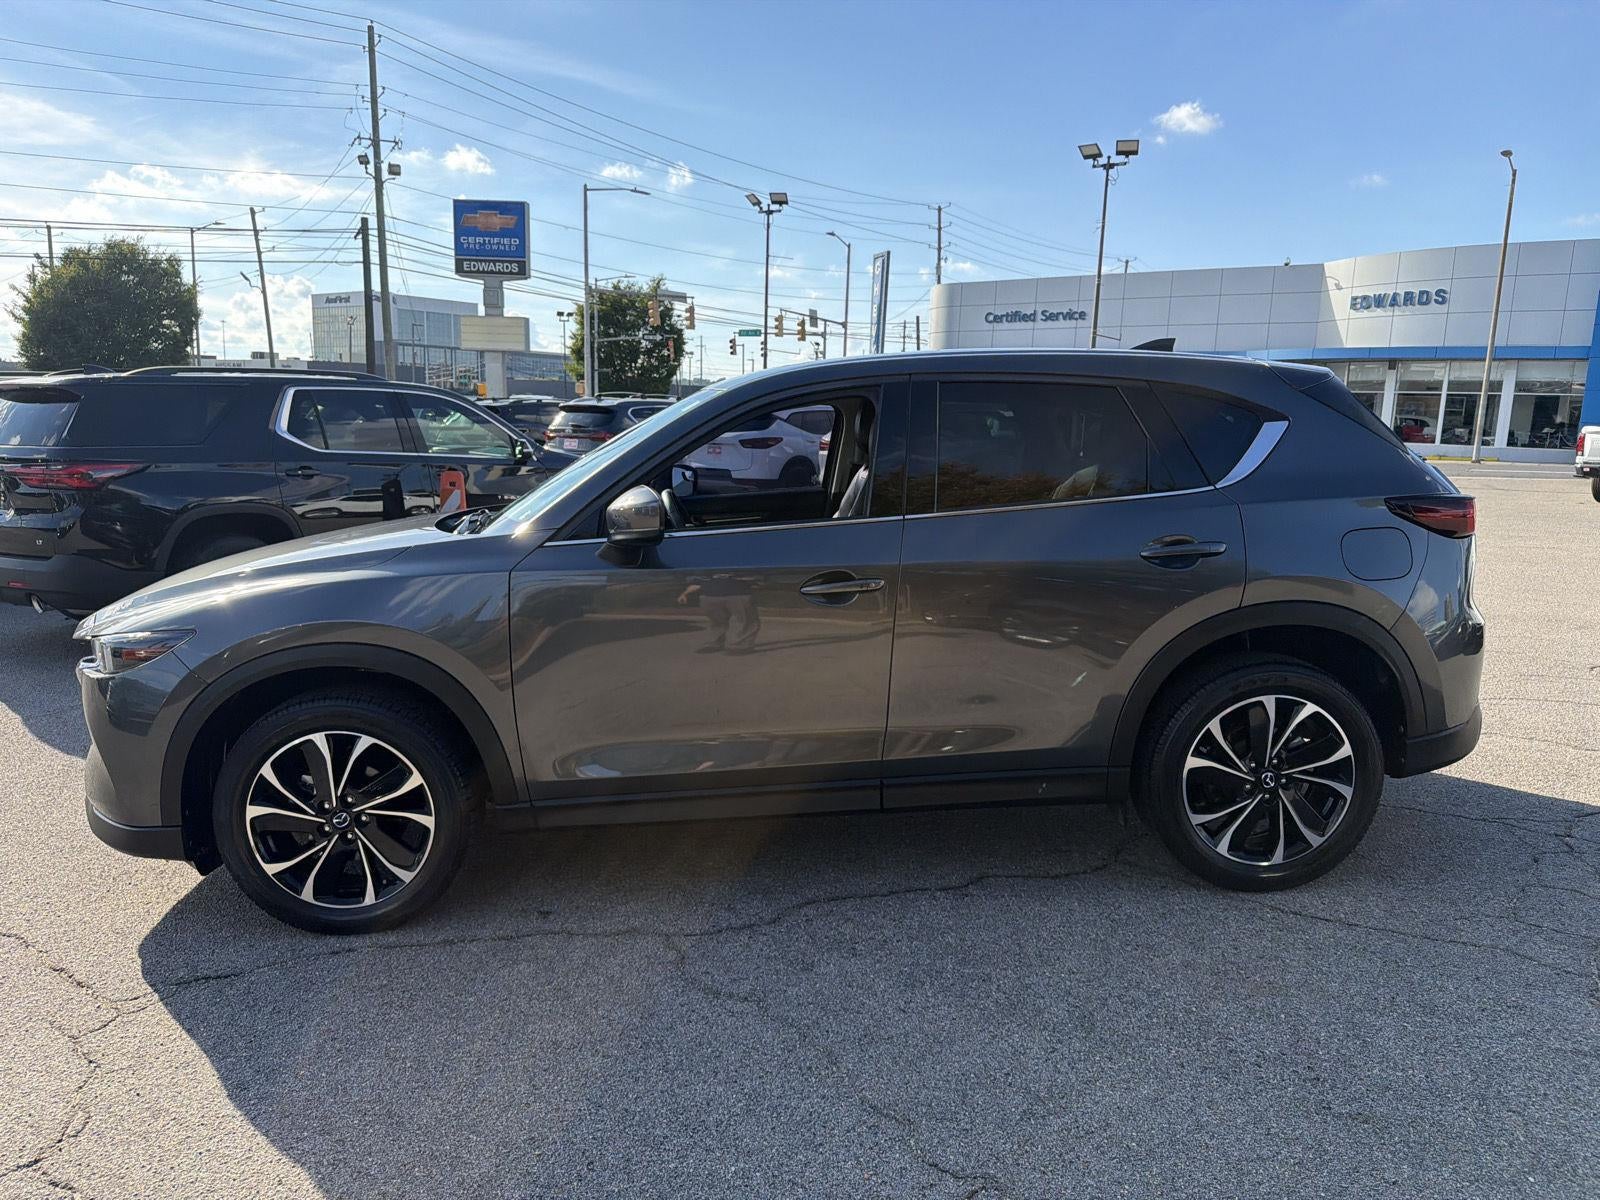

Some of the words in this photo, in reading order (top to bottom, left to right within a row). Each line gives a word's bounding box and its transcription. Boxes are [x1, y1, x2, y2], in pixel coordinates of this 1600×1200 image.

[460, 236, 519, 245] CERTIFIED
[463, 261, 519, 273] EDWARDS
[1350, 288, 1449, 311] EDWARDS
[984, 309, 1037, 324] Certified
[1040, 307, 1087, 322] Service
